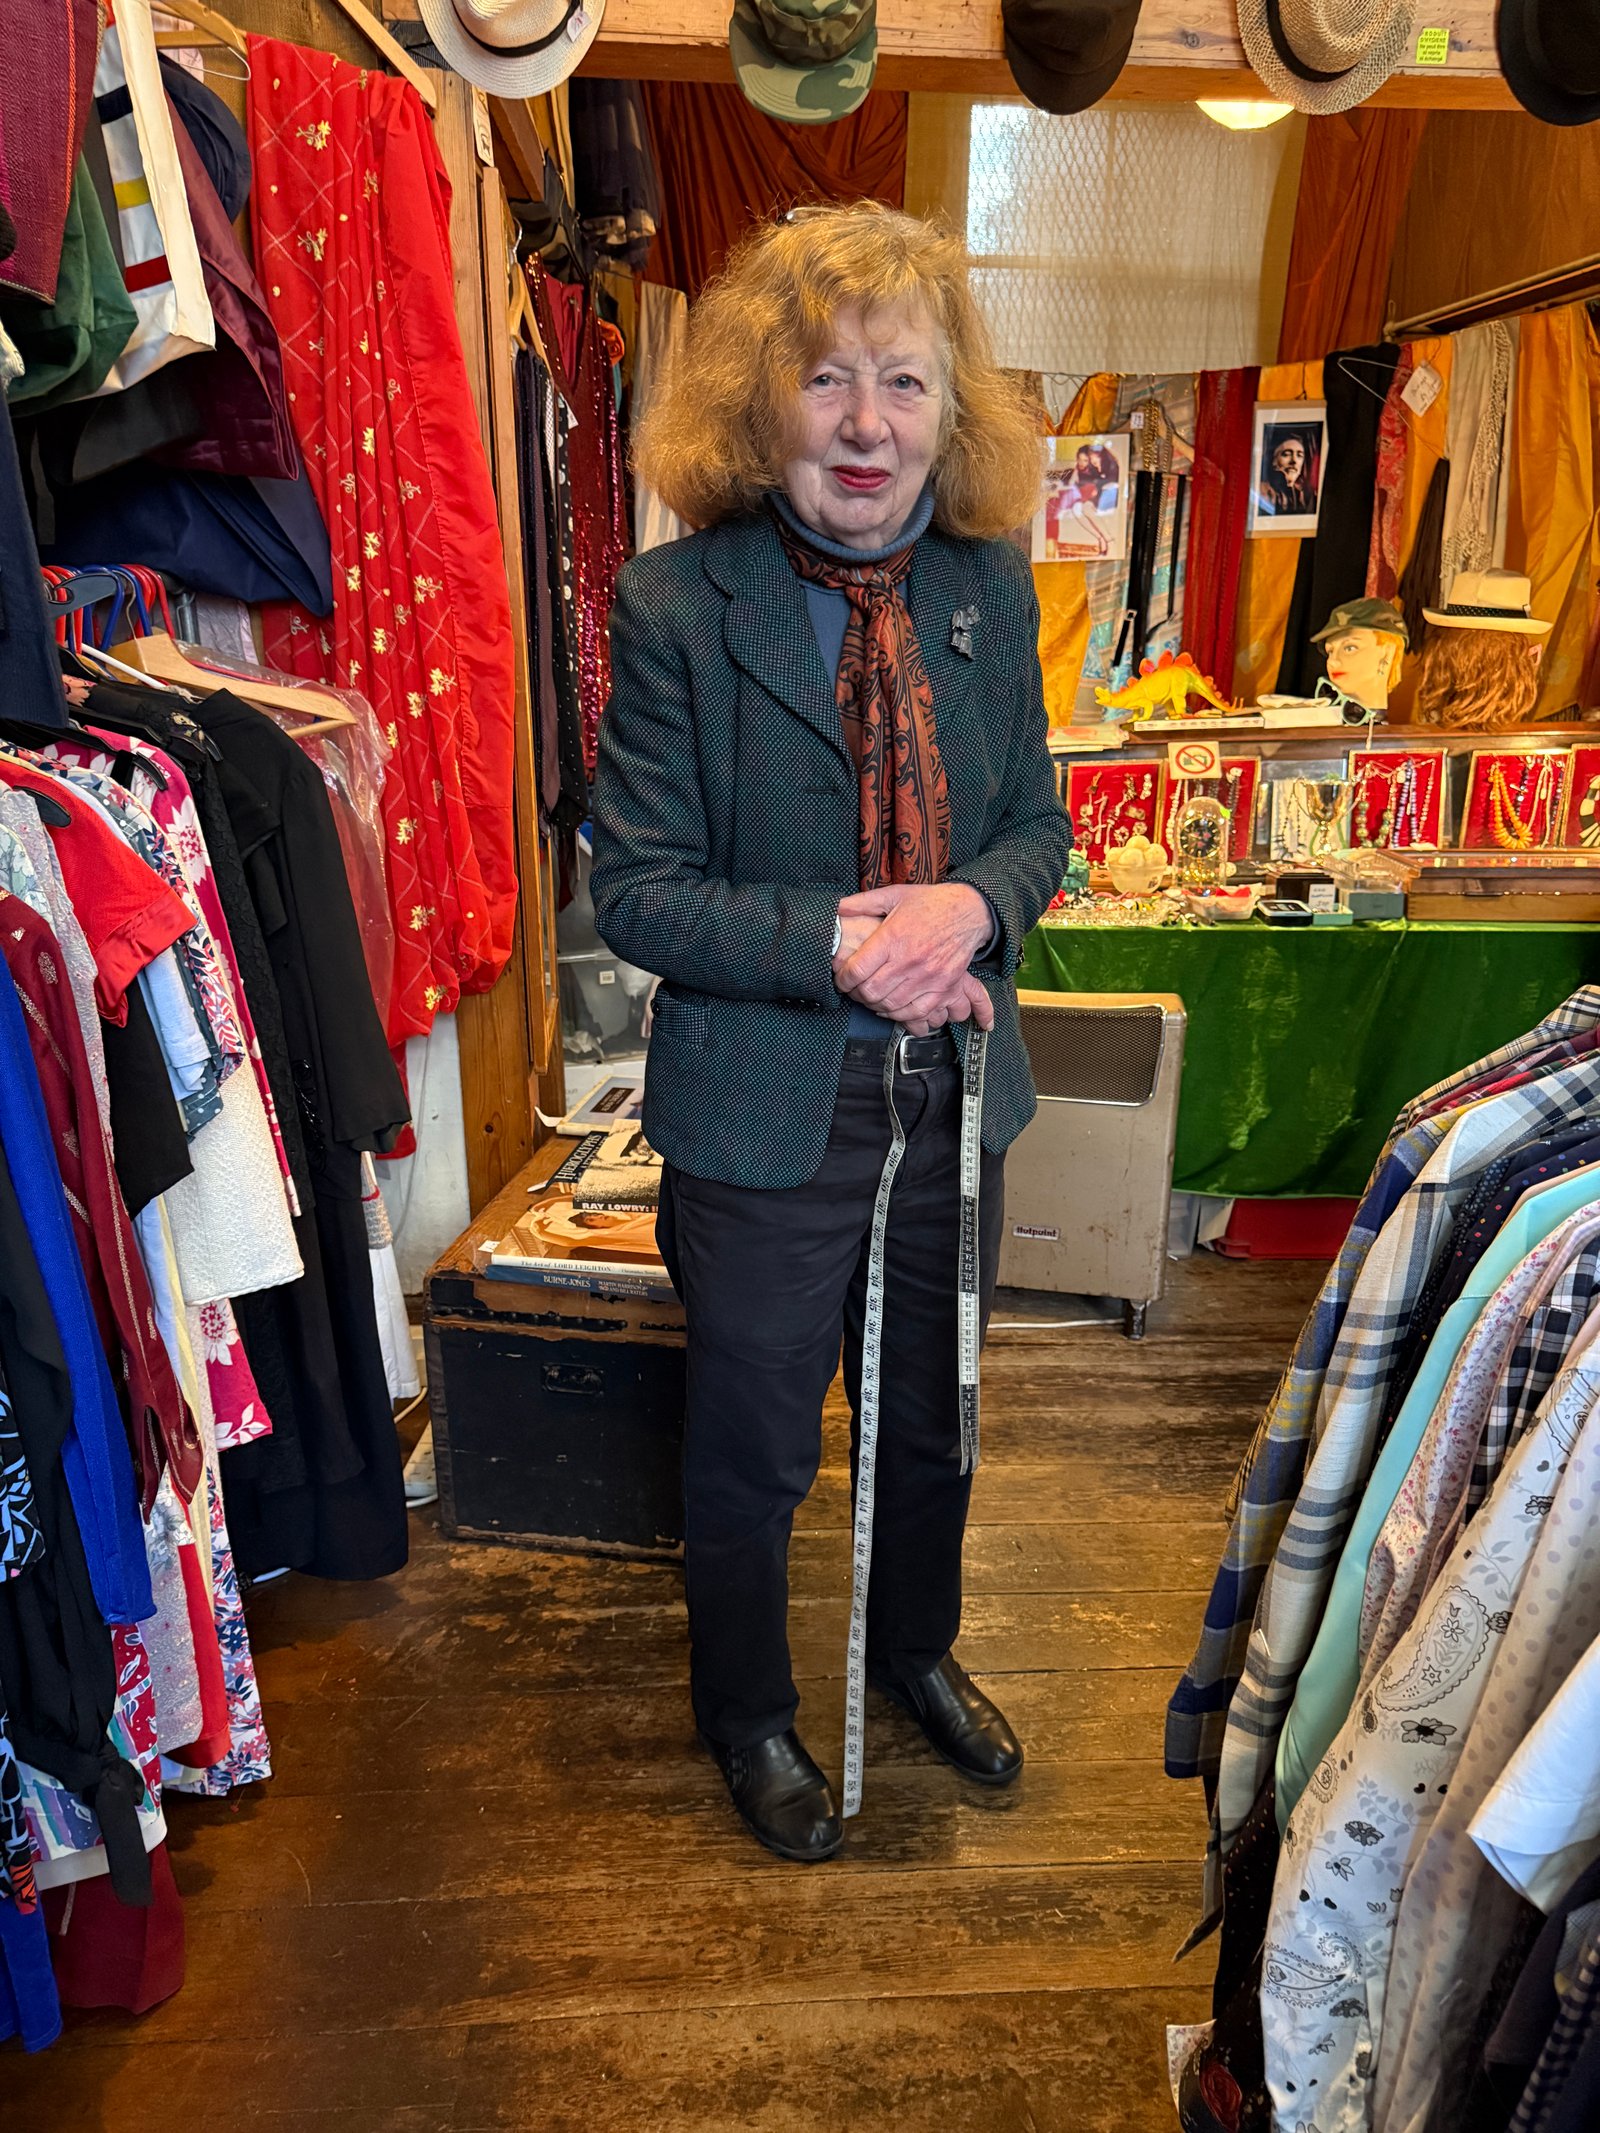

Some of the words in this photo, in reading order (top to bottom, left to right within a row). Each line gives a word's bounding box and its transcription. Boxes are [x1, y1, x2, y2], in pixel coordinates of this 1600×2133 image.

[554, 1134, 602, 1180] HIEROGLYPHS
[889, 1150, 898, 1167] 29
[881, 1175, 890, 1192] 30
[608, 1204, 649, 1212] LOWRY:
[877, 1200, 884, 1215] 31
[873, 1224, 881, 1240] 32
[1017, 1226, 1056, 1238] Hotpoint
[871, 1248, 879, 1264] 33
[544, 1276, 591, 1288] BURNE-JONES
[871, 1272, 879, 1288] 34
[869, 1296, 877, 1312] 35
[868, 1319, 876, 1336] 36
[866, 1342, 875, 1358] 37
[865, 1365, 874, 1380] 38
[864, 1388, 873, 1402] 39
[864, 1409, 872, 1425] 40
[863, 1432, 871, 1445] 41
[862, 1454, 870, 1470] 42
[860, 1476, 868, 1492] 43
[859, 1498, 868, 1512] 44
[858, 1520, 866, 1534] 45
[856, 1541, 866, 1556] 46
[856, 1563, 864, 1579] 47
[853, 1606, 860, 1620] 49
[851, 1626, 860, 1641] 50
[850, 1647, 859, 1660] 51
[850, 1666, 858, 1680] 52
[850, 1685, 858, 1700] 53
[849, 1705, 858, 1718] 54
[848, 1724, 857, 1737] 55
[847, 1761, 857, 1774] 57
